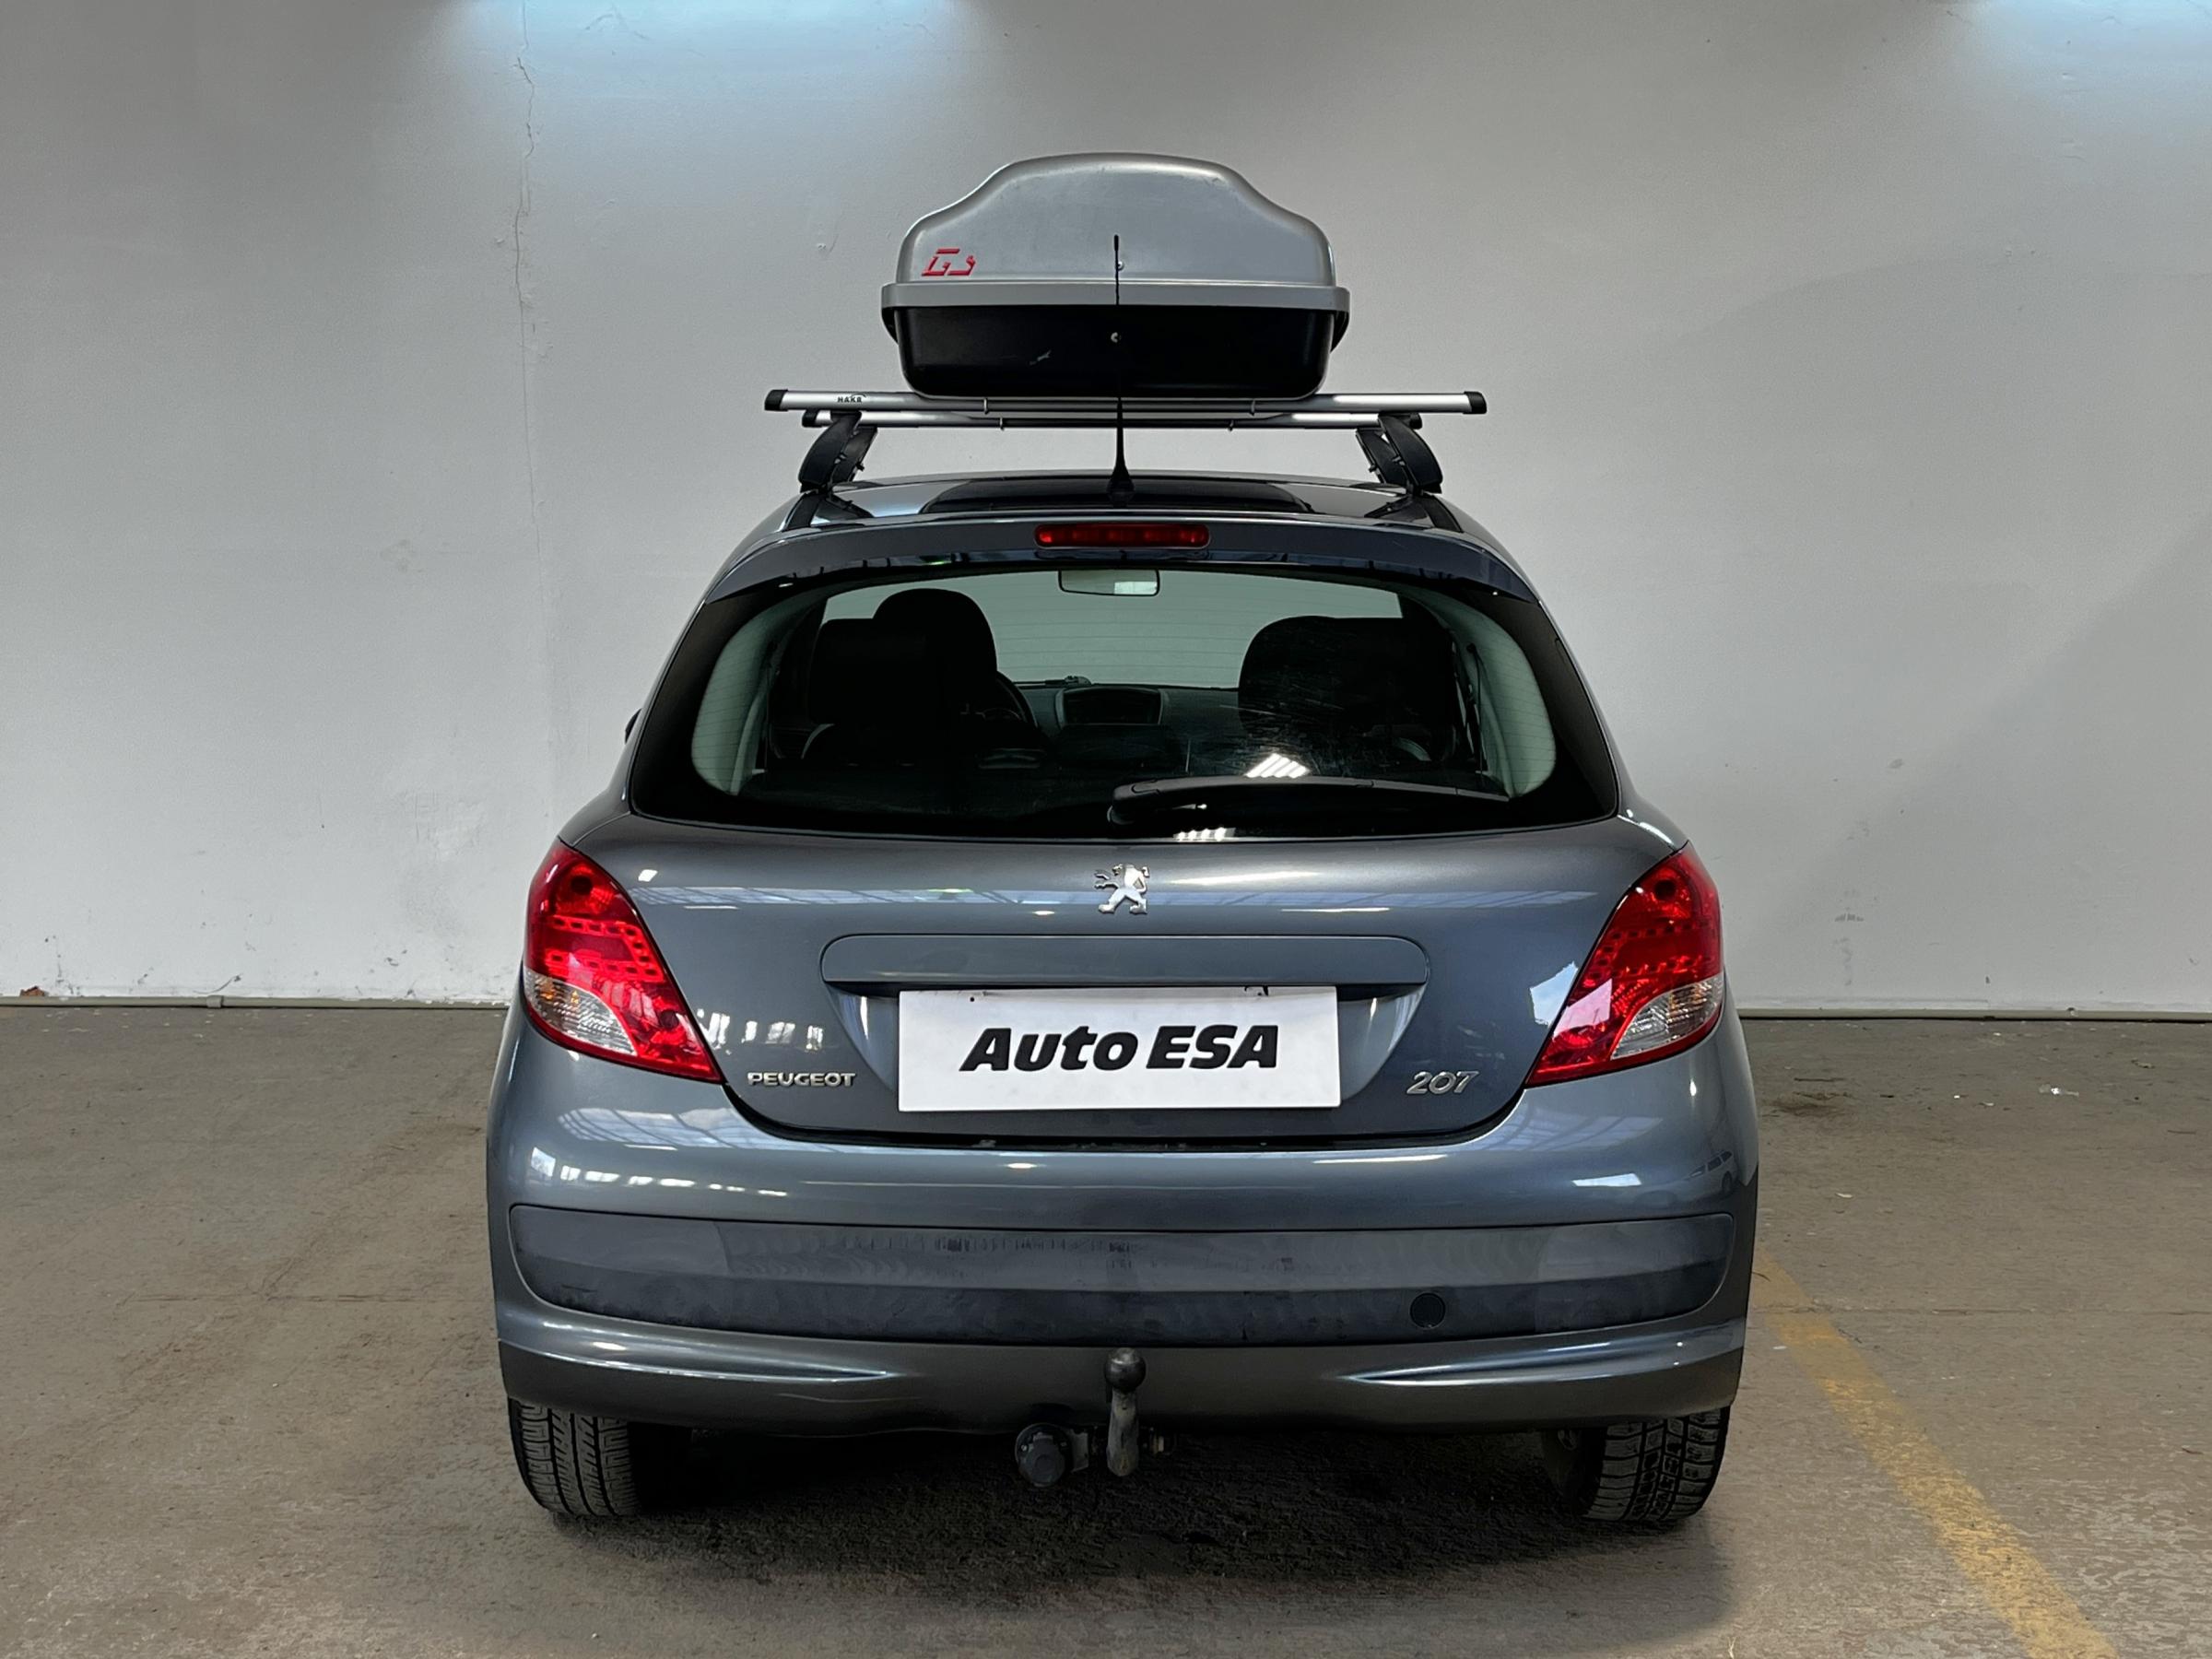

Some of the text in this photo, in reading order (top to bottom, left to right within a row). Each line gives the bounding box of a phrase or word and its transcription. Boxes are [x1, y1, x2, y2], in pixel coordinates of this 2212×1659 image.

[959, 1024, 1278, 1072] Auto ESA
[747, 1071, 856, 1088] PEUGEOT
[1406, 1070, 1480, 1095] 207
